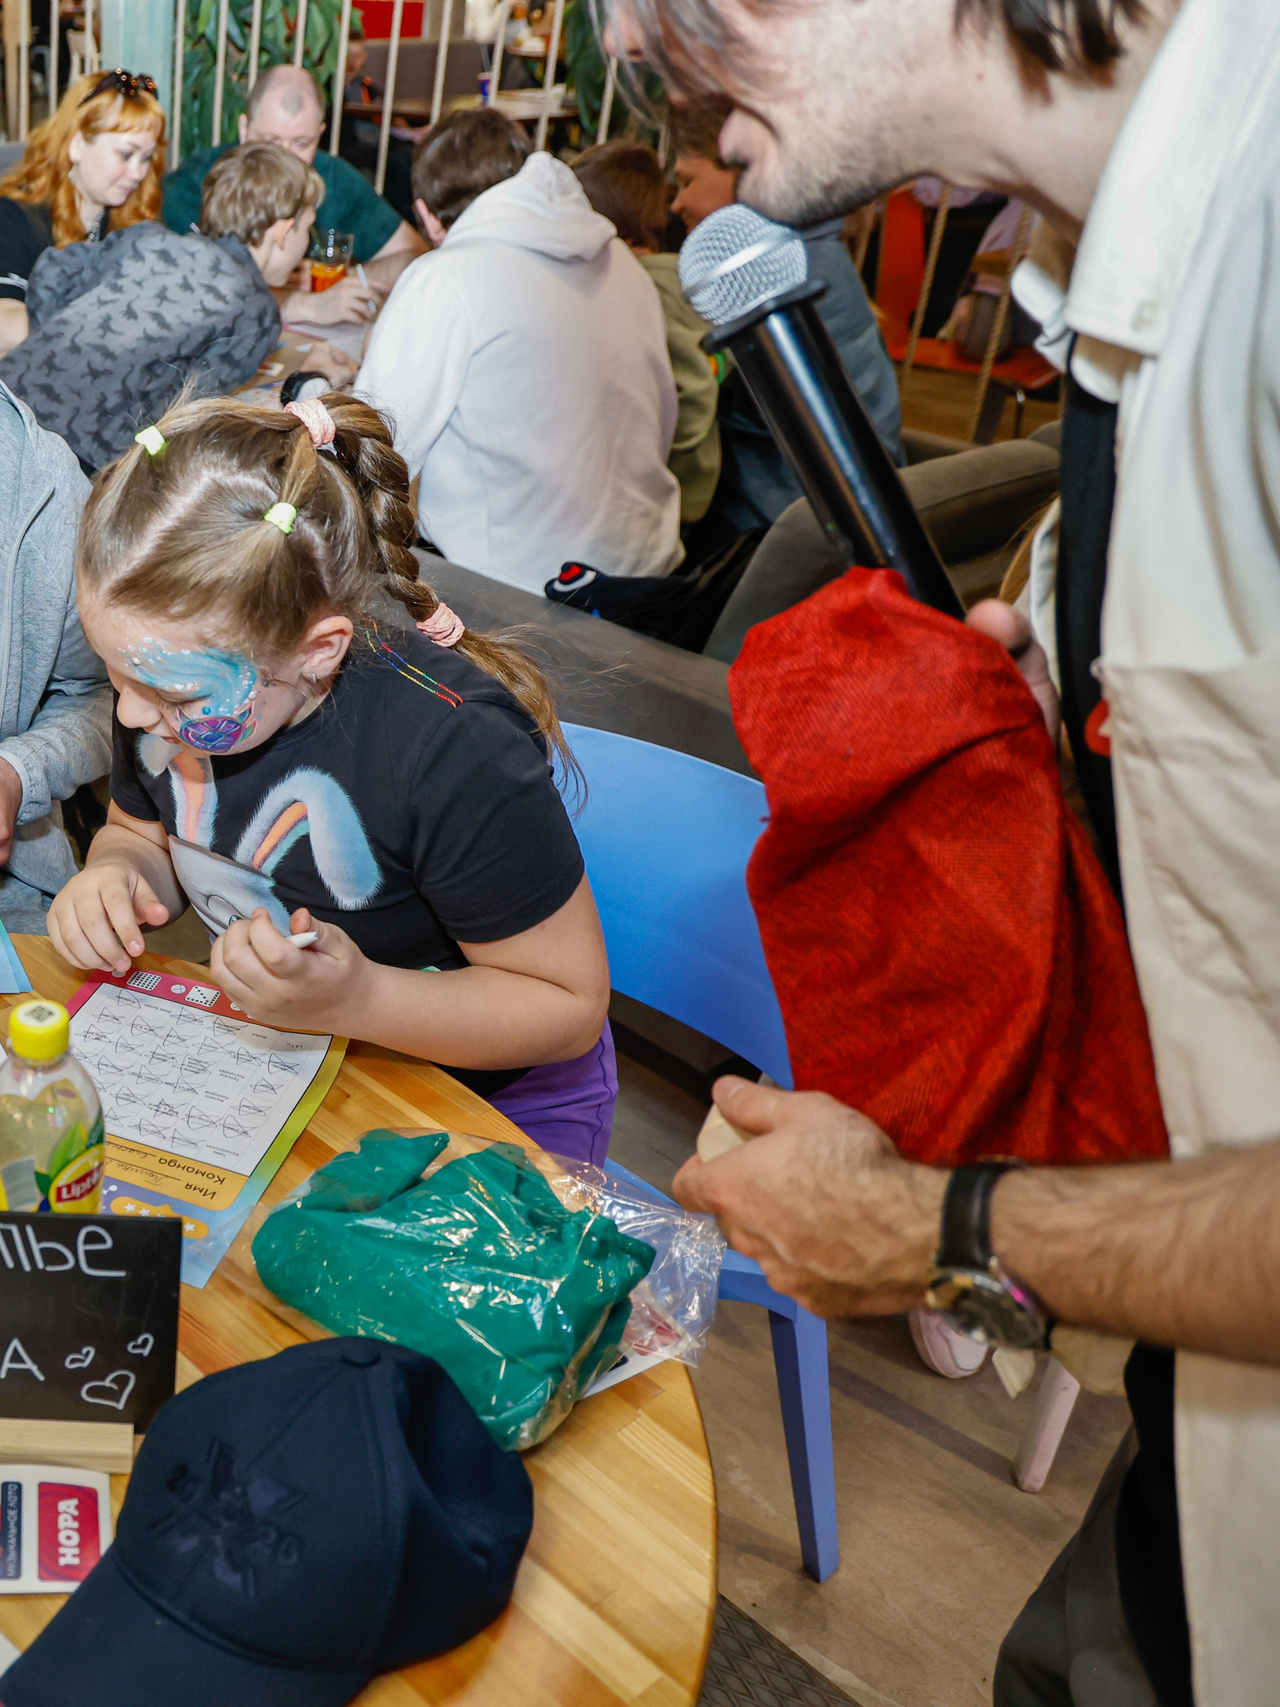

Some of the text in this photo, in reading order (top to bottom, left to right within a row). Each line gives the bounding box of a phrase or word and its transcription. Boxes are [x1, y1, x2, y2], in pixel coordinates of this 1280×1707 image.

[158, 1157, 226, 1186] Команда
[184, 1182, 217, 1200] Имя
[57, 1498, 81, 1567] НОРА
